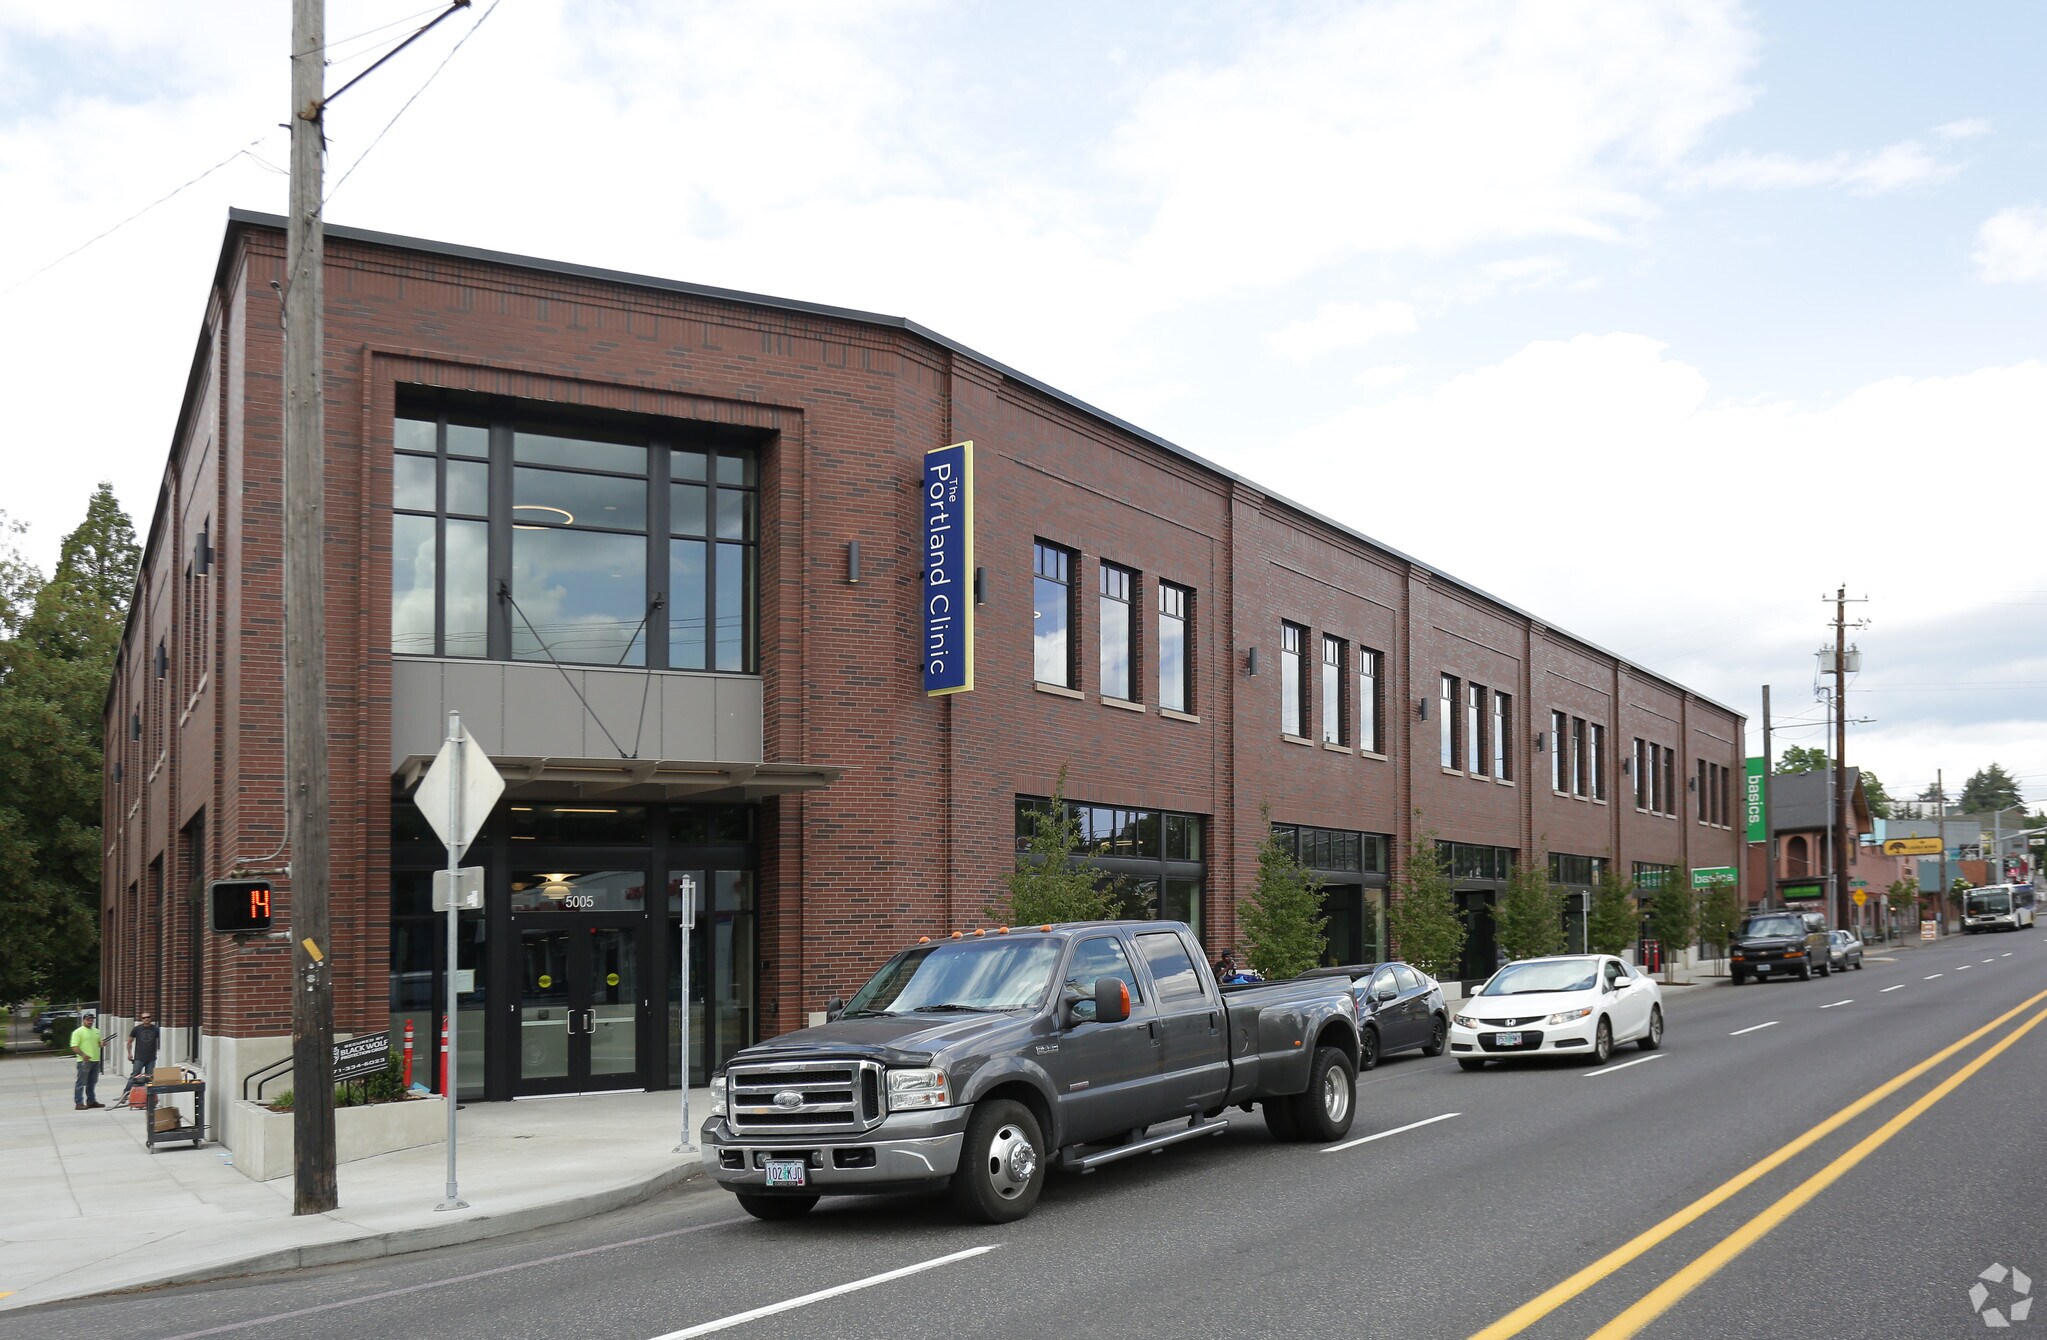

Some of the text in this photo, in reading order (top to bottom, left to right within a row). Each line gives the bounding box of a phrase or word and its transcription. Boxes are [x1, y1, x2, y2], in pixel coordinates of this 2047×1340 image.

[949, 477, 958, 503] The
[930, 463, 951, 675] Portland Clinic
[250, 890, 270, 918] 14
[565, 895, 594, 908] 5005
[340, 1039, 388, 1056] BLACK WOLF
[344, 1038, 374, 1048] SECURED
[340, 1050, 371, 1060] PROTECTION
[333, 1057, 386, 1074] 71-334-6023
[768, 1167, 803, 1180] 102 KJD
